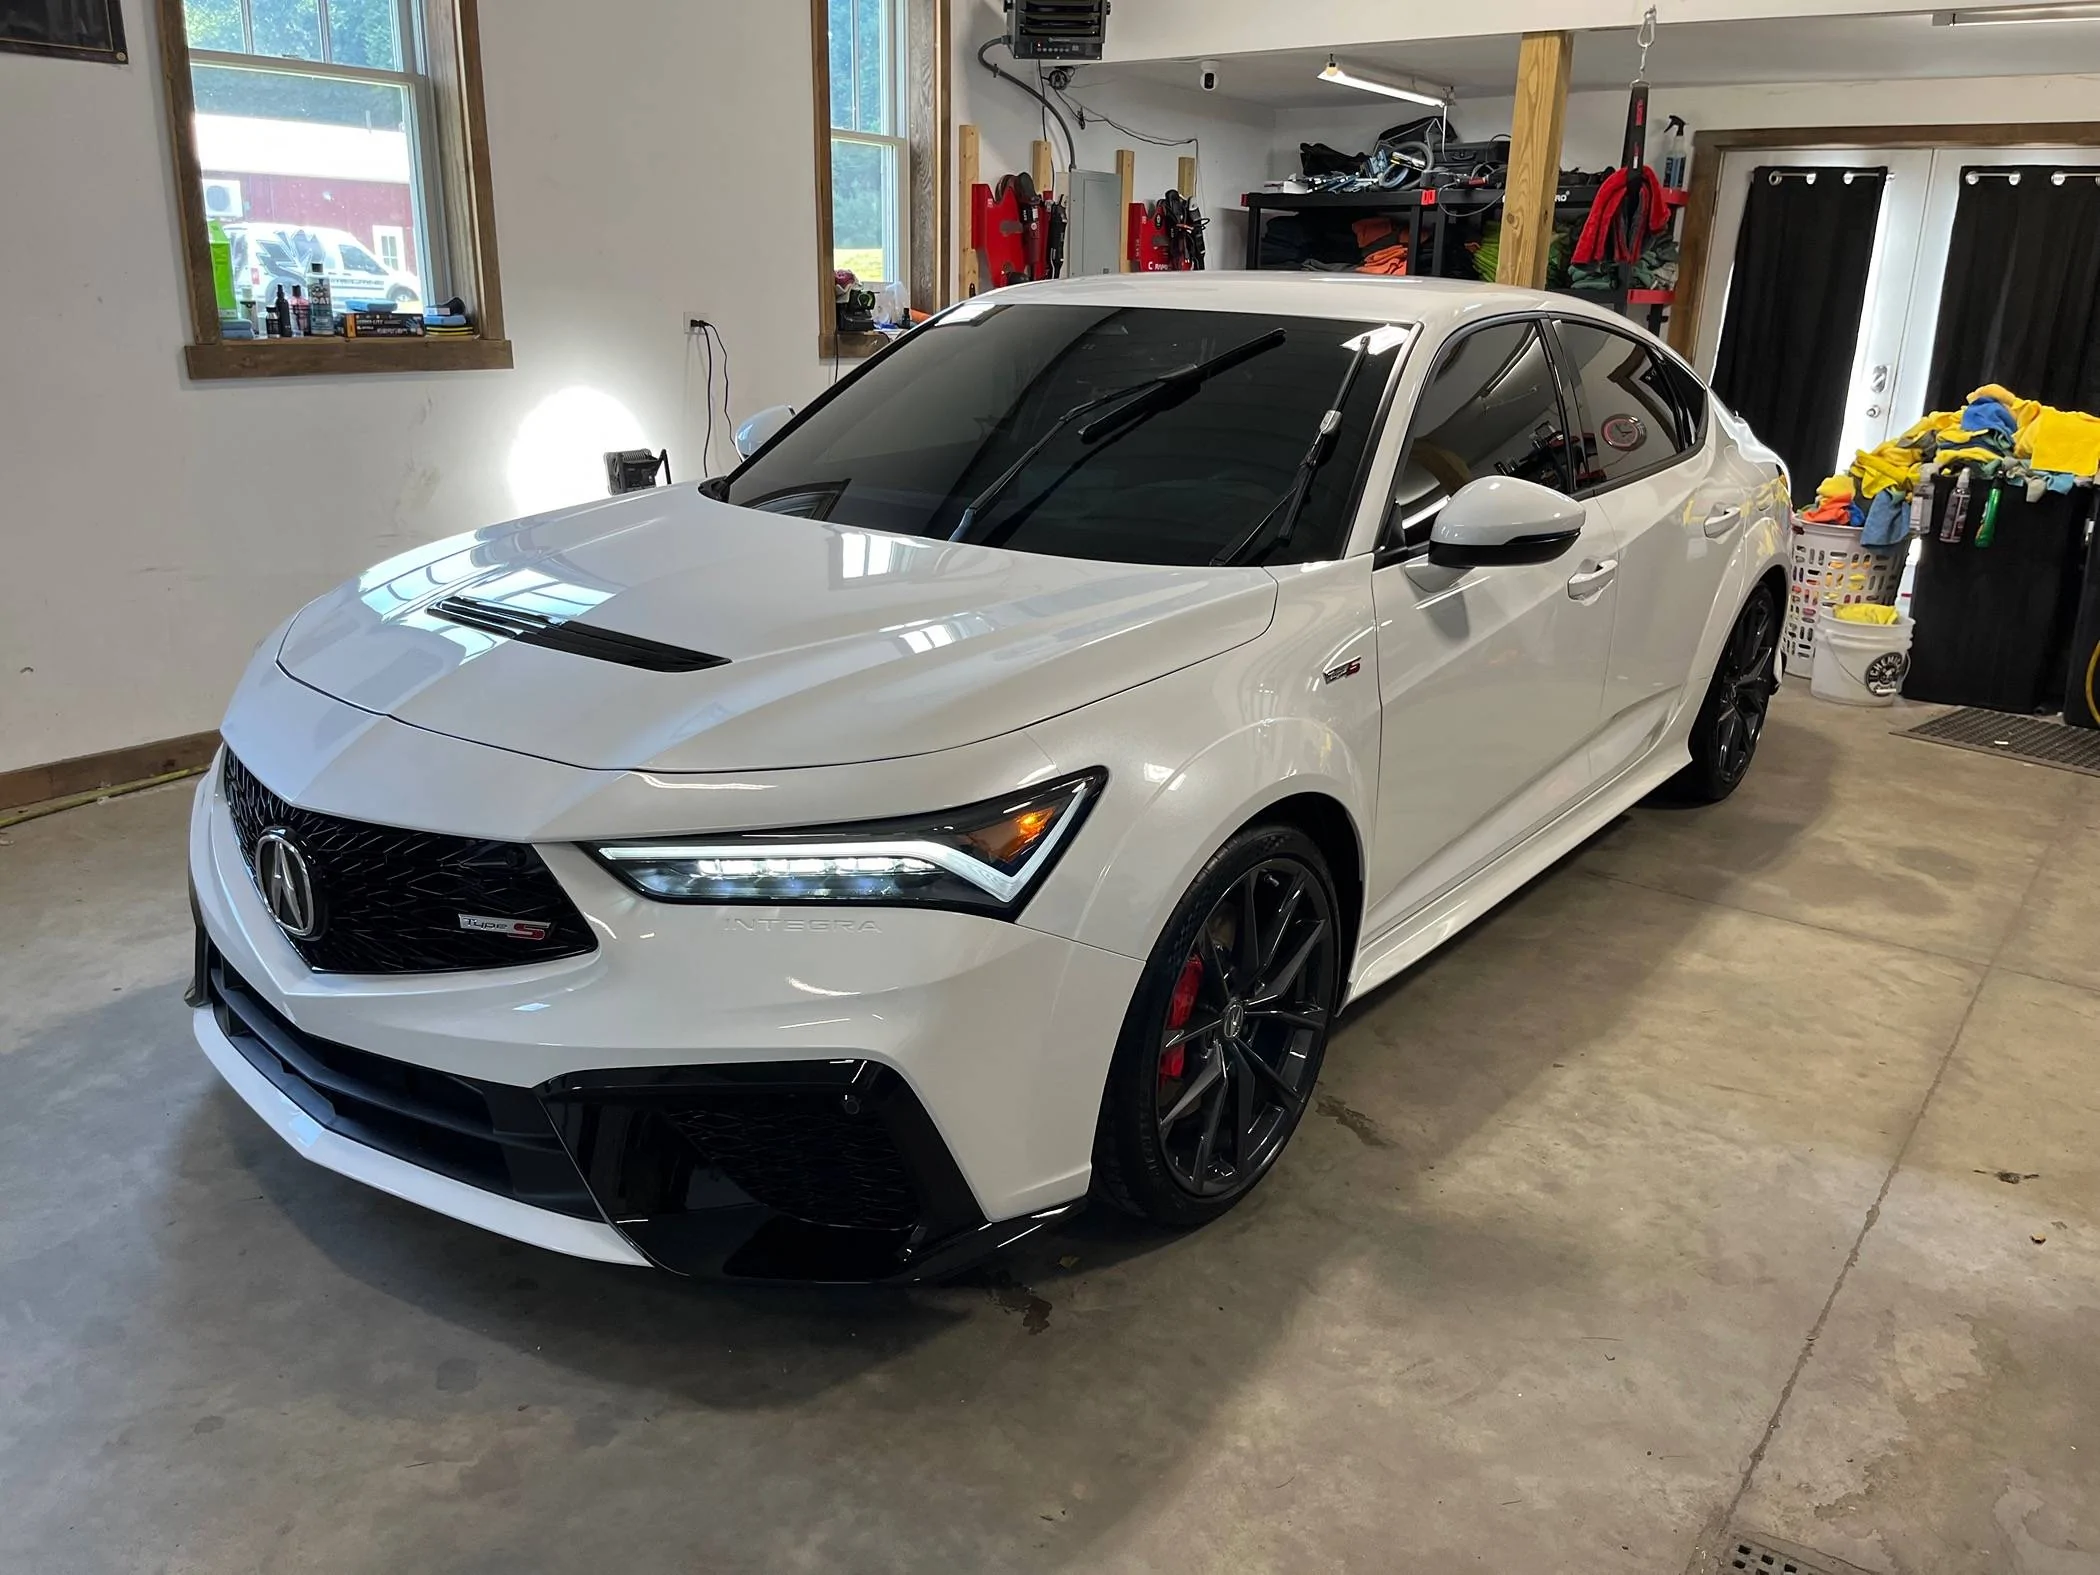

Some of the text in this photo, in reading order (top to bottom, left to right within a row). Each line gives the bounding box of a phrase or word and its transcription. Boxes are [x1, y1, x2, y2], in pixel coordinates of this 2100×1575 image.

[462, 917, 548, 941] Type S
[724, 918, 883, 934] INTEGRA
